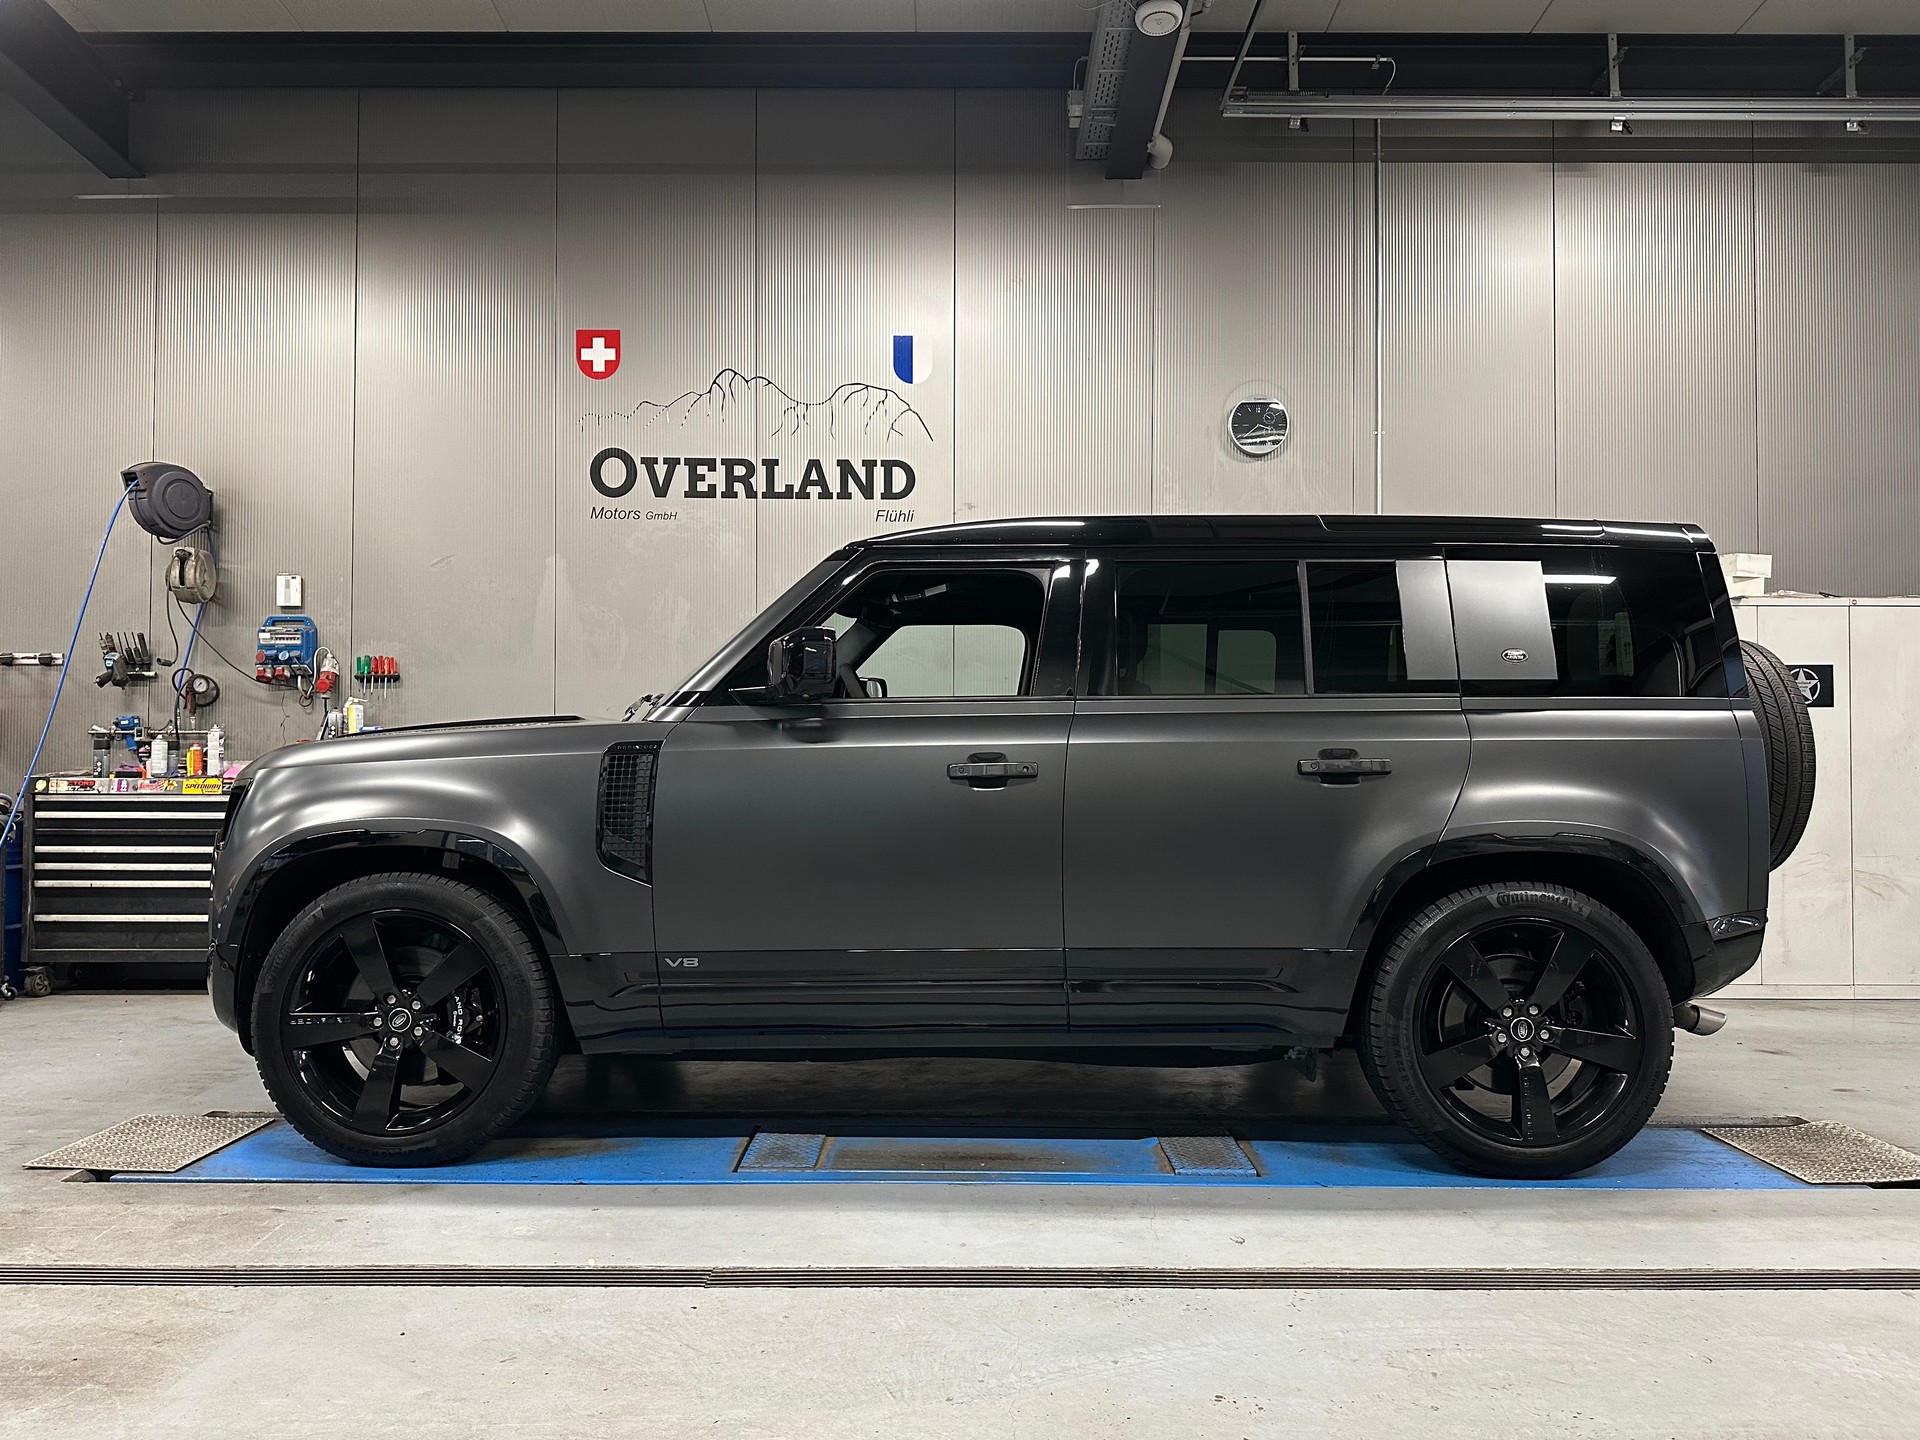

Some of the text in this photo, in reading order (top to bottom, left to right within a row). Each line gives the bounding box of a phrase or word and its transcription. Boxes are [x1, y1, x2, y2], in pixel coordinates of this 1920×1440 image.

[590, 447, 916, 500] OVERLAND
[590, 506, 678, 521] Motors GmbH
[875, 509, 915, 523] Flühli
[664, 957, 699, 968] V8
[453, 994, 463, 1016] AND
